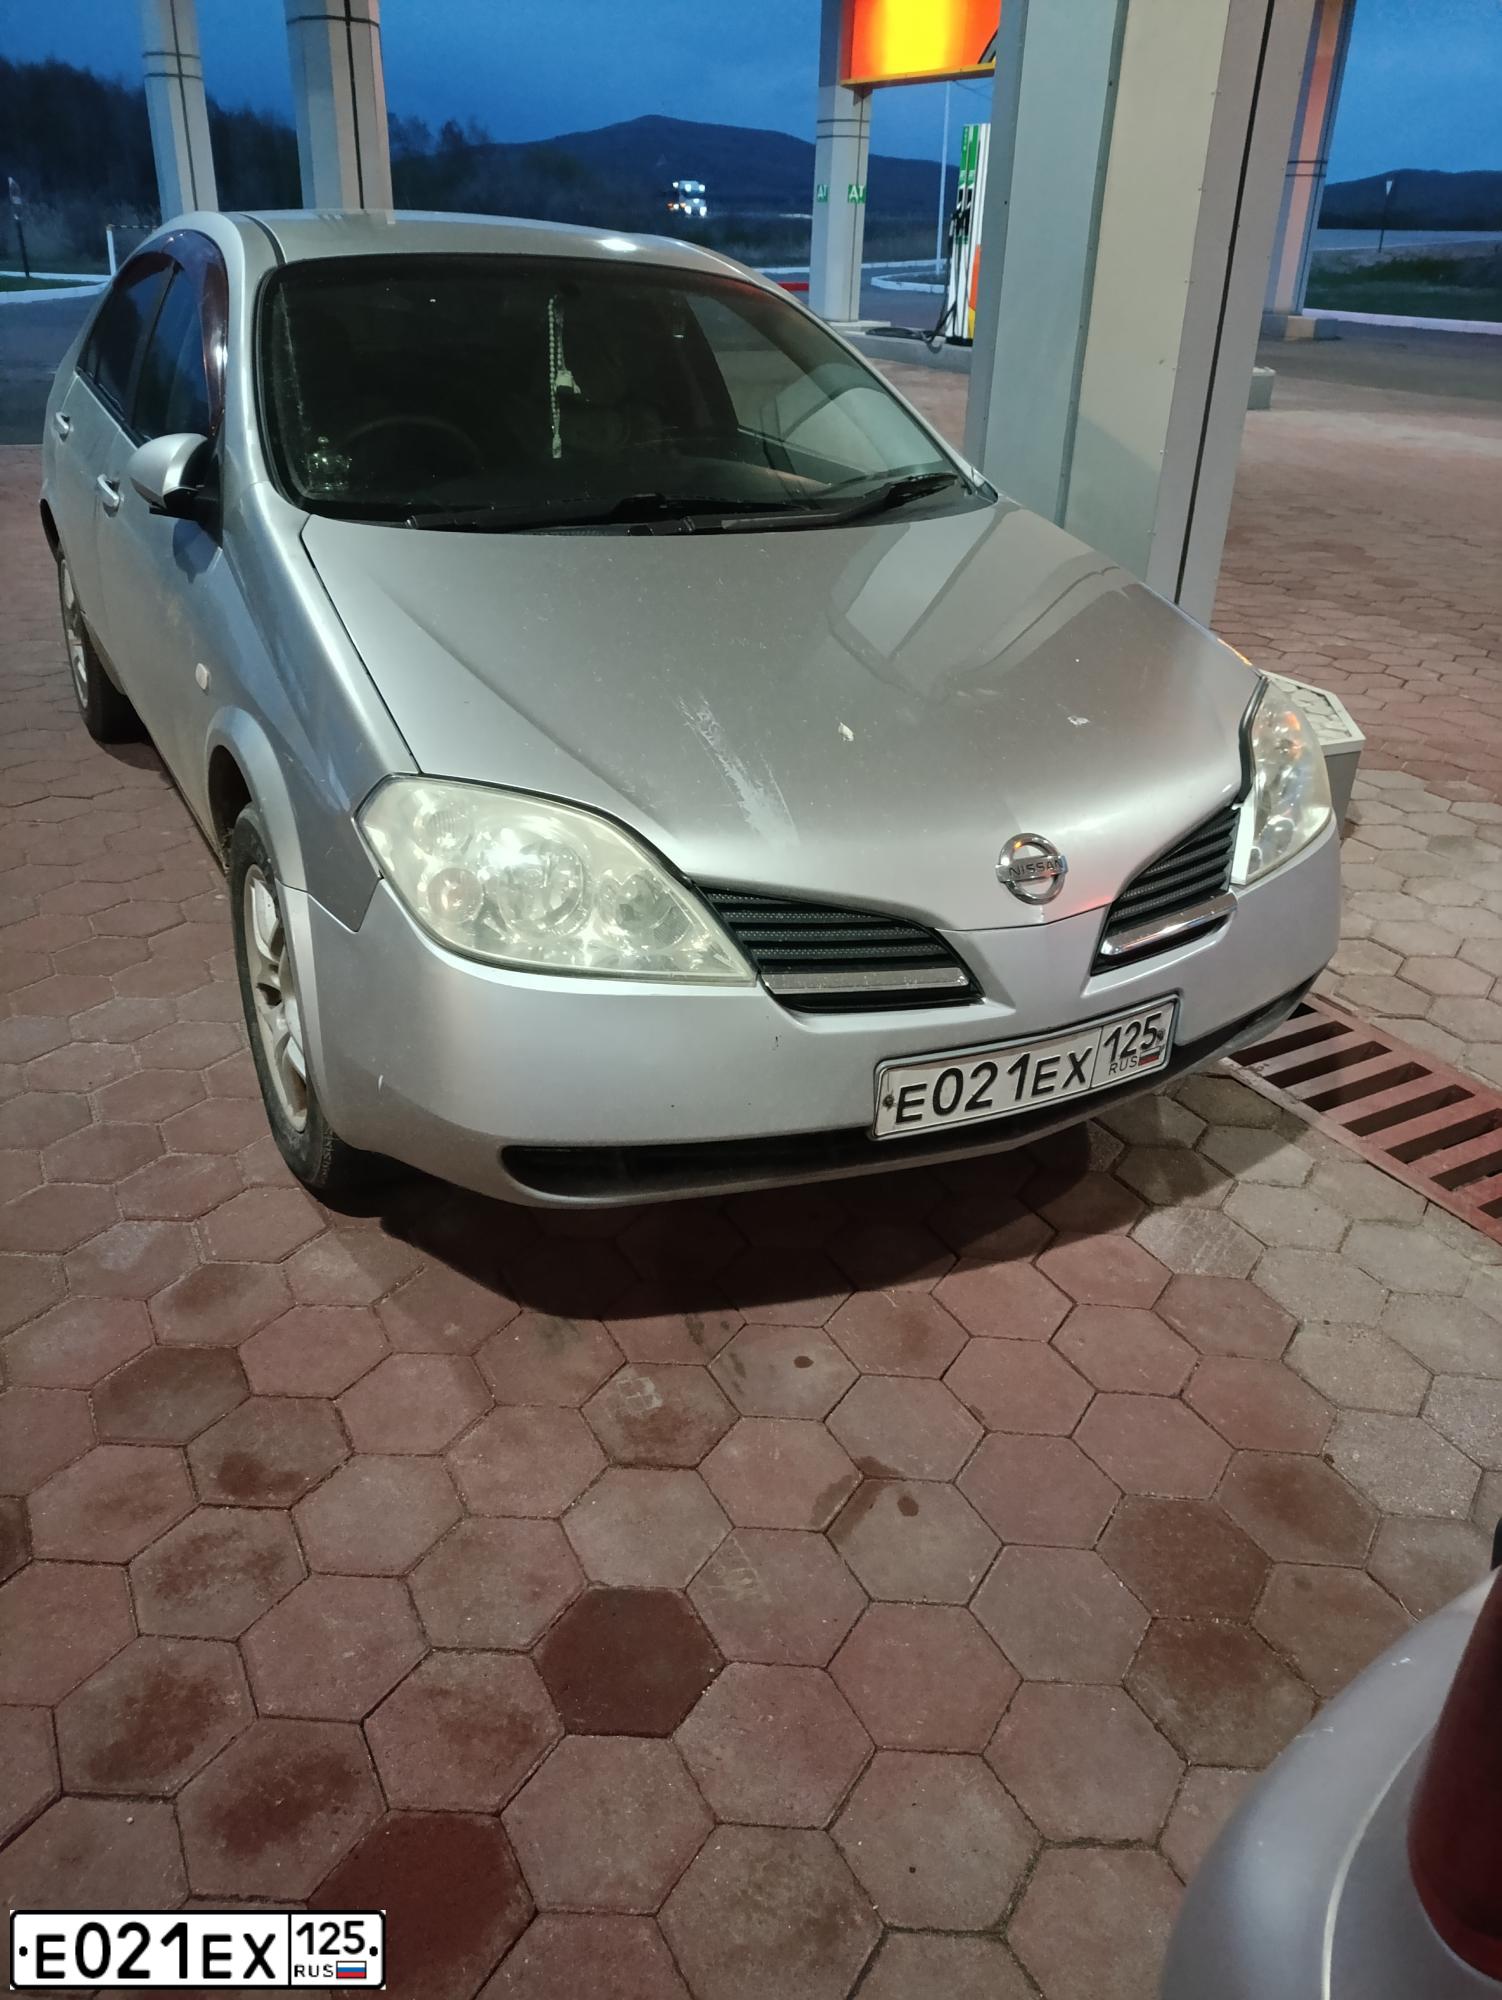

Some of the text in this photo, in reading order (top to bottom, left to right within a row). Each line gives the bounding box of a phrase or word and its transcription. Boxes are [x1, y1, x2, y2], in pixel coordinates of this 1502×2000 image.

[1008, 860, 1064, 876] NISSAN
[895, 1012, 1162, 1123] E021EX 125
[1108, 1056, 1138, 1076] RUS
